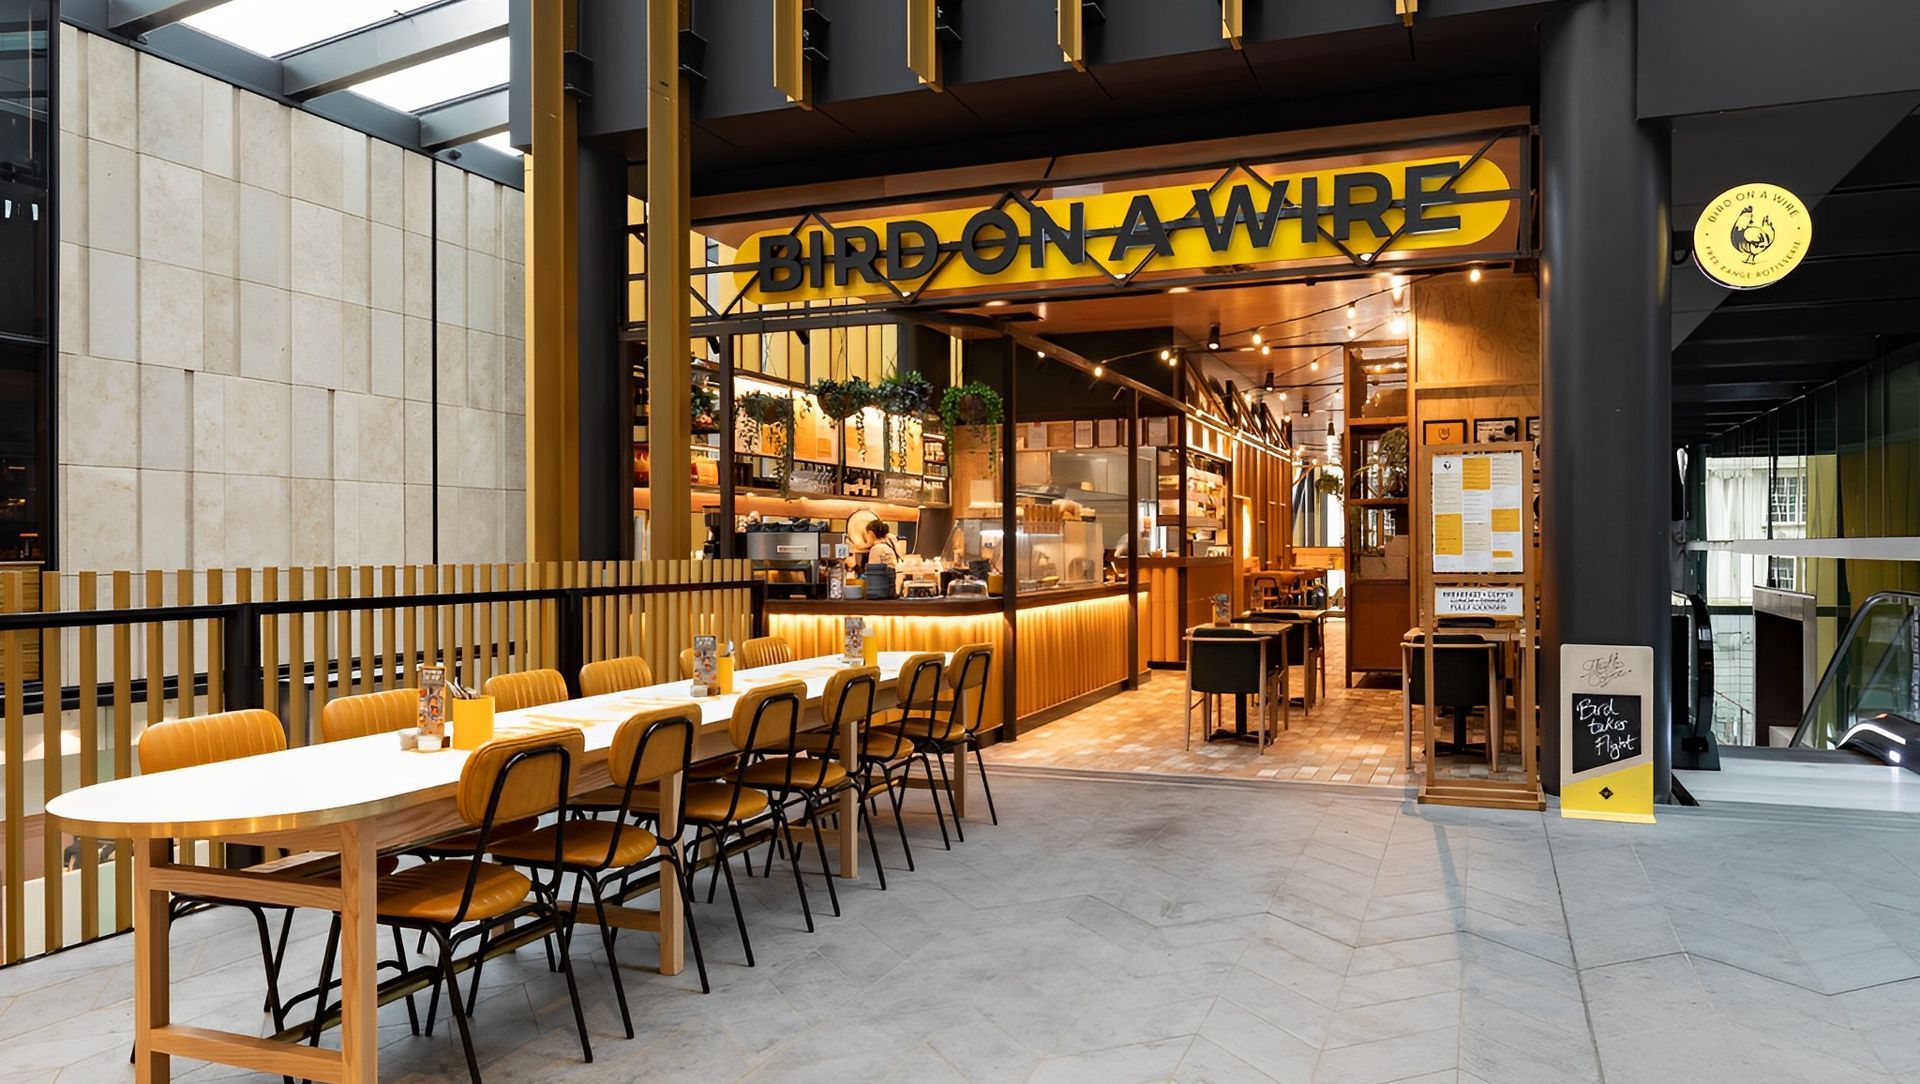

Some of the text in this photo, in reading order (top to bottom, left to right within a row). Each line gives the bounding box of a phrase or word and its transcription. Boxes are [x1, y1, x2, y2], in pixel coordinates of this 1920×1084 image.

[1708, 190, 1800, 223] BIRD ON A WIRE
[759, 161, 1462, 293] BIRD ON A WIRE
[1576, 697, 1619, 721] Bird
[1588, 718, 1628, 735] takes
